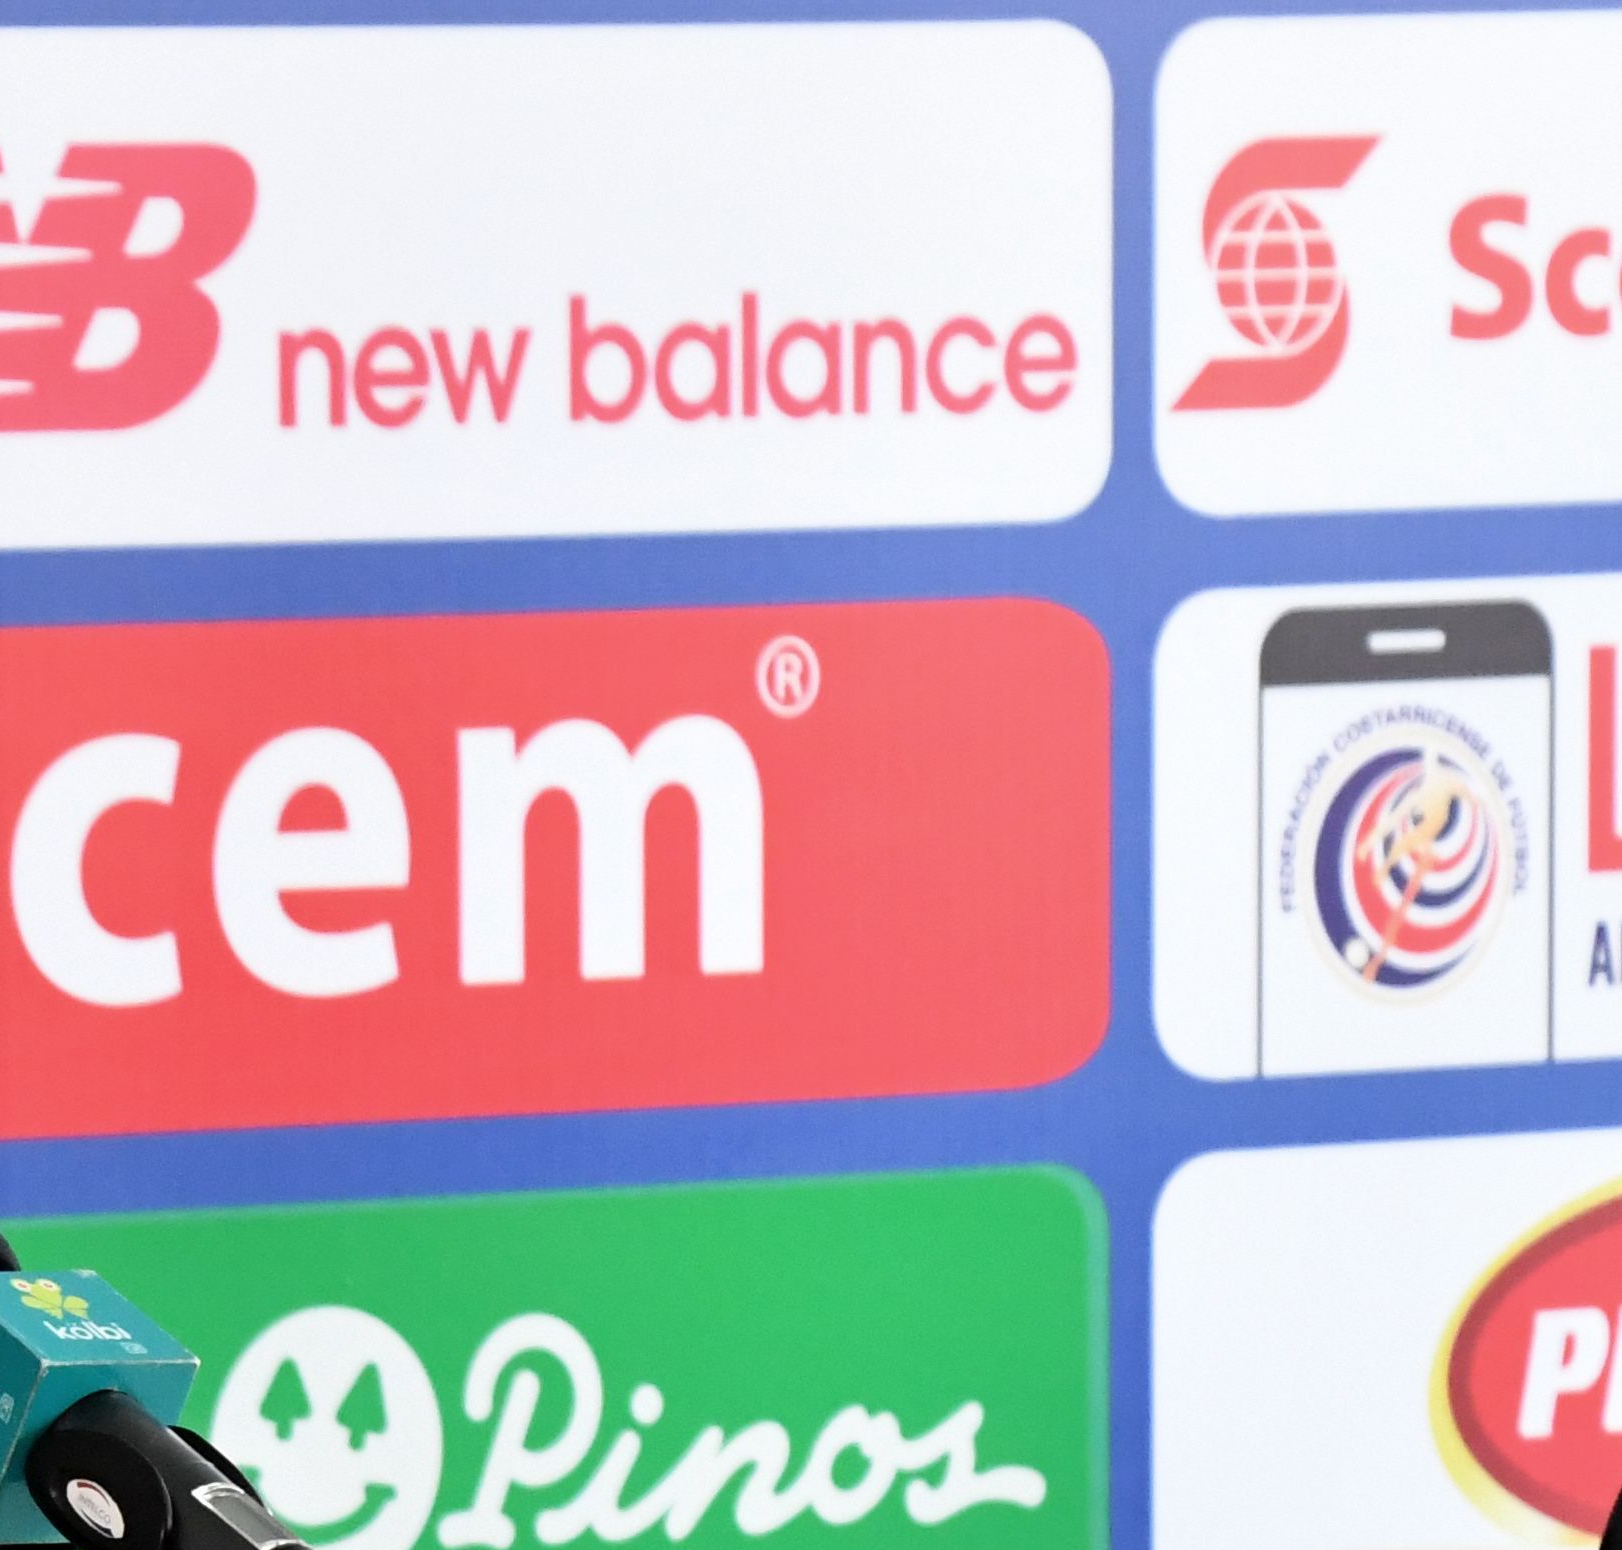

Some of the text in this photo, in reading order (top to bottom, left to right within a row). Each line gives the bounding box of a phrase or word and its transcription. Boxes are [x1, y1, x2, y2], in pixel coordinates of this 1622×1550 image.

[276, 291, 1080, 429] new balance
[436, 1312, 1047, 1550] Pinos
